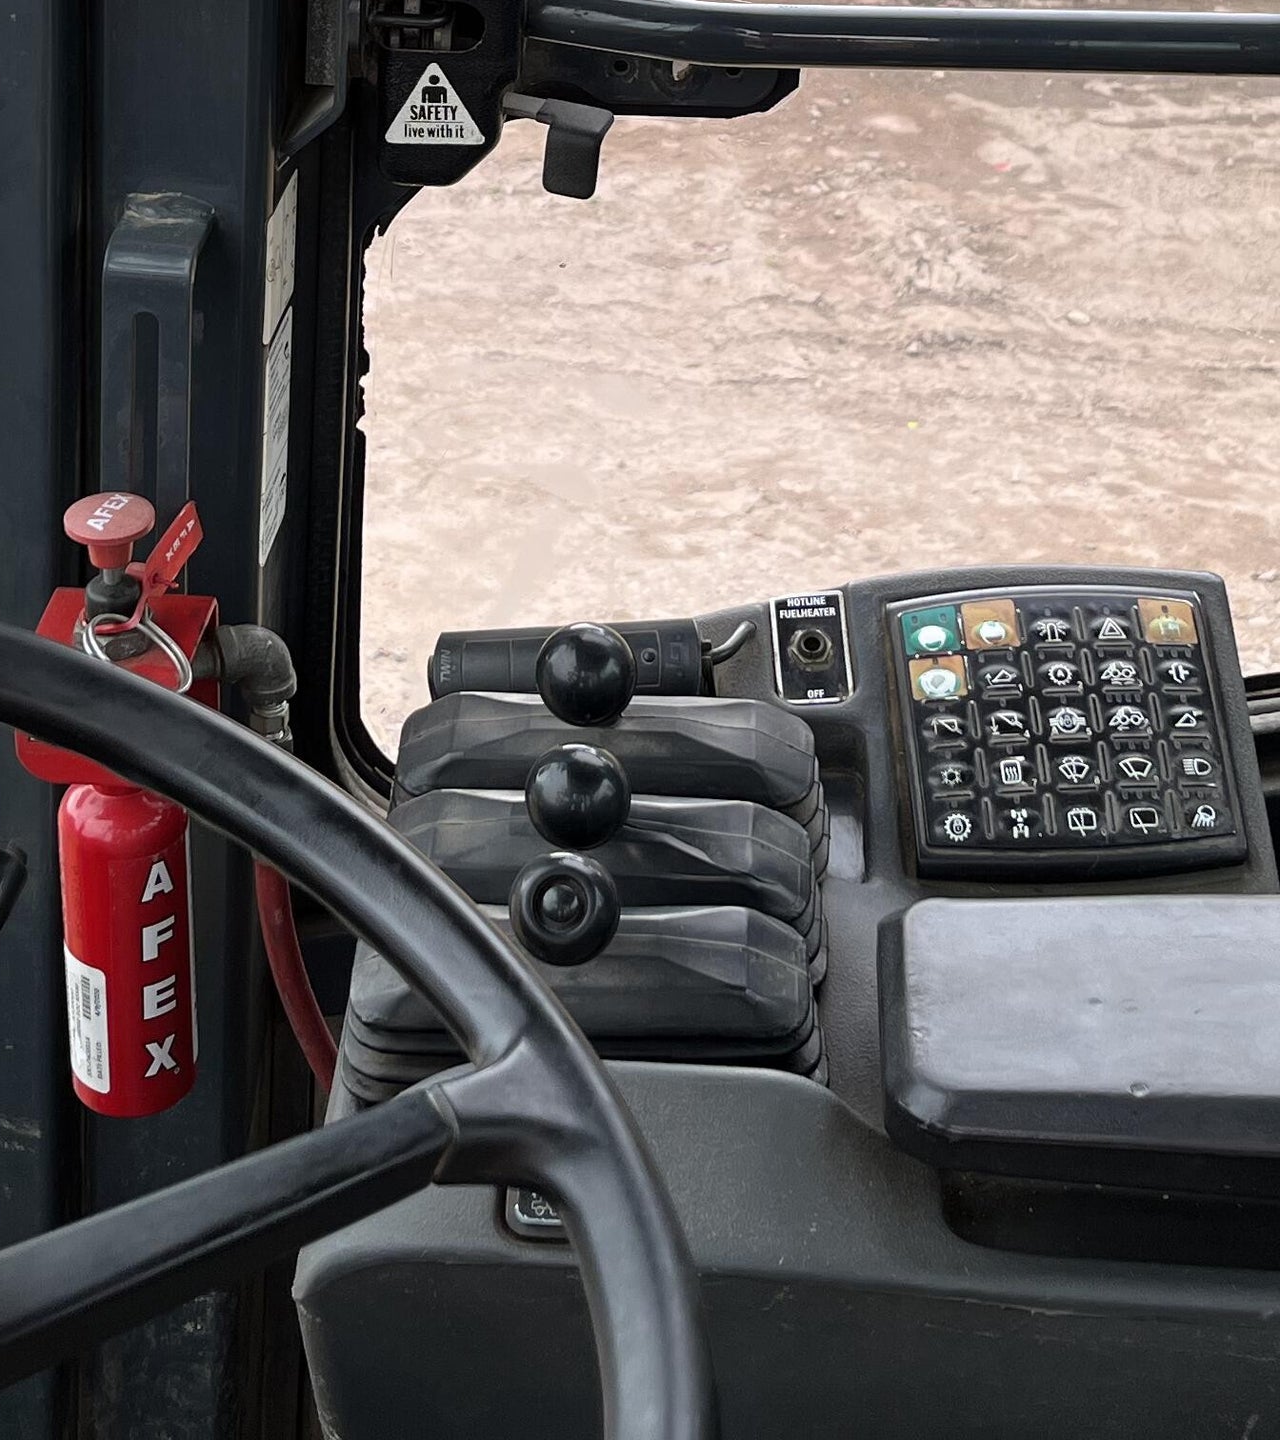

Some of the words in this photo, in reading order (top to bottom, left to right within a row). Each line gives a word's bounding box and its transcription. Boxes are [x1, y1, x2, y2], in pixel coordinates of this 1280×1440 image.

[410, 105, 458, 120] SAFETY
[405, 124, 424, 138] live
[427, 125, 452, 138] with
[455, 125, 464, 138] it
[86, 493, 133, 532] AFEX
[165, 520, 195, 562] AFEX
[787, 597, 826, 606] HOTLINE
[780, 607, 836, 618] FUELHEATER
[440, 649, 452, 683] TWIN
[807, 689, 824, 698] OFF
[141, 859, 178, 1078] AFEX
